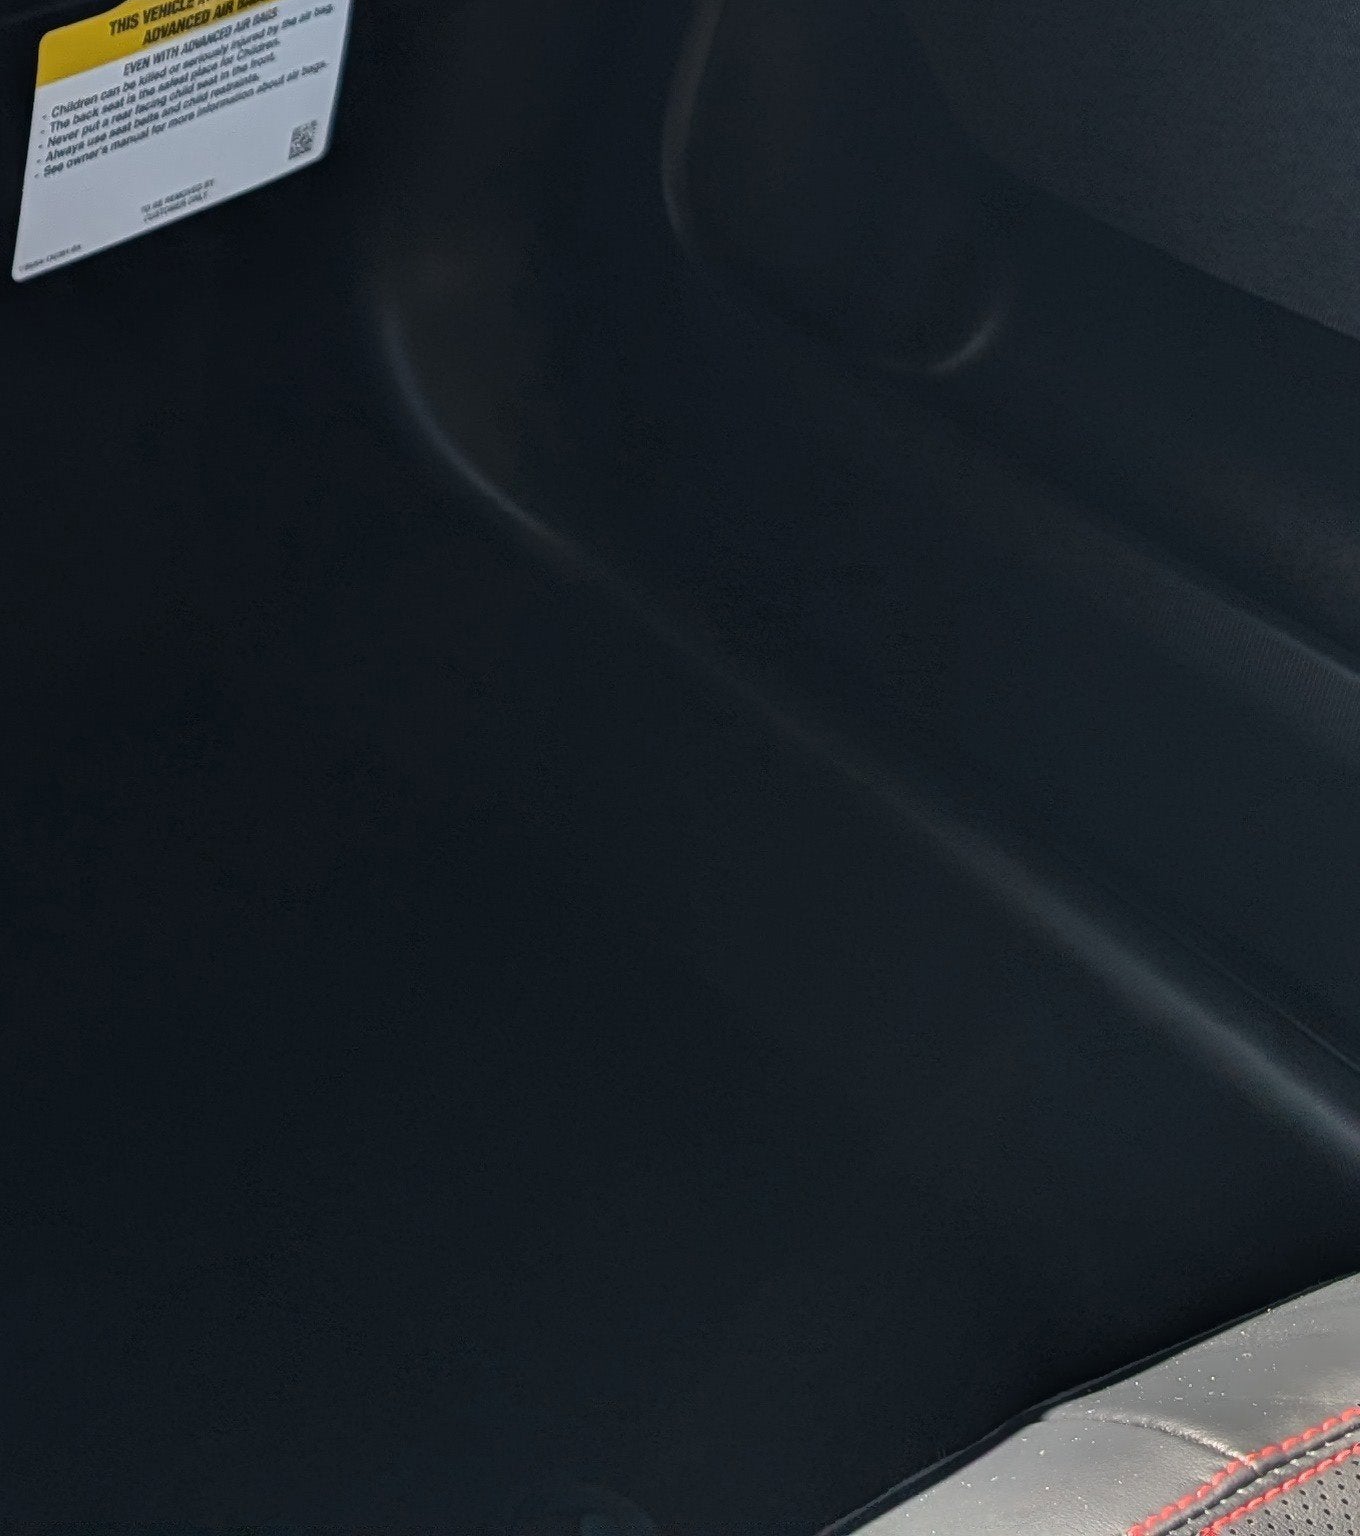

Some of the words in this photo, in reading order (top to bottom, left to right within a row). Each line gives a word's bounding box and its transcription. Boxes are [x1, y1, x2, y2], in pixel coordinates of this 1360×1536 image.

[109, 12, 139, 35] THIS
[142, 9, 210, 44] ADVANCED
[212, 0, 234, 19] AIR
